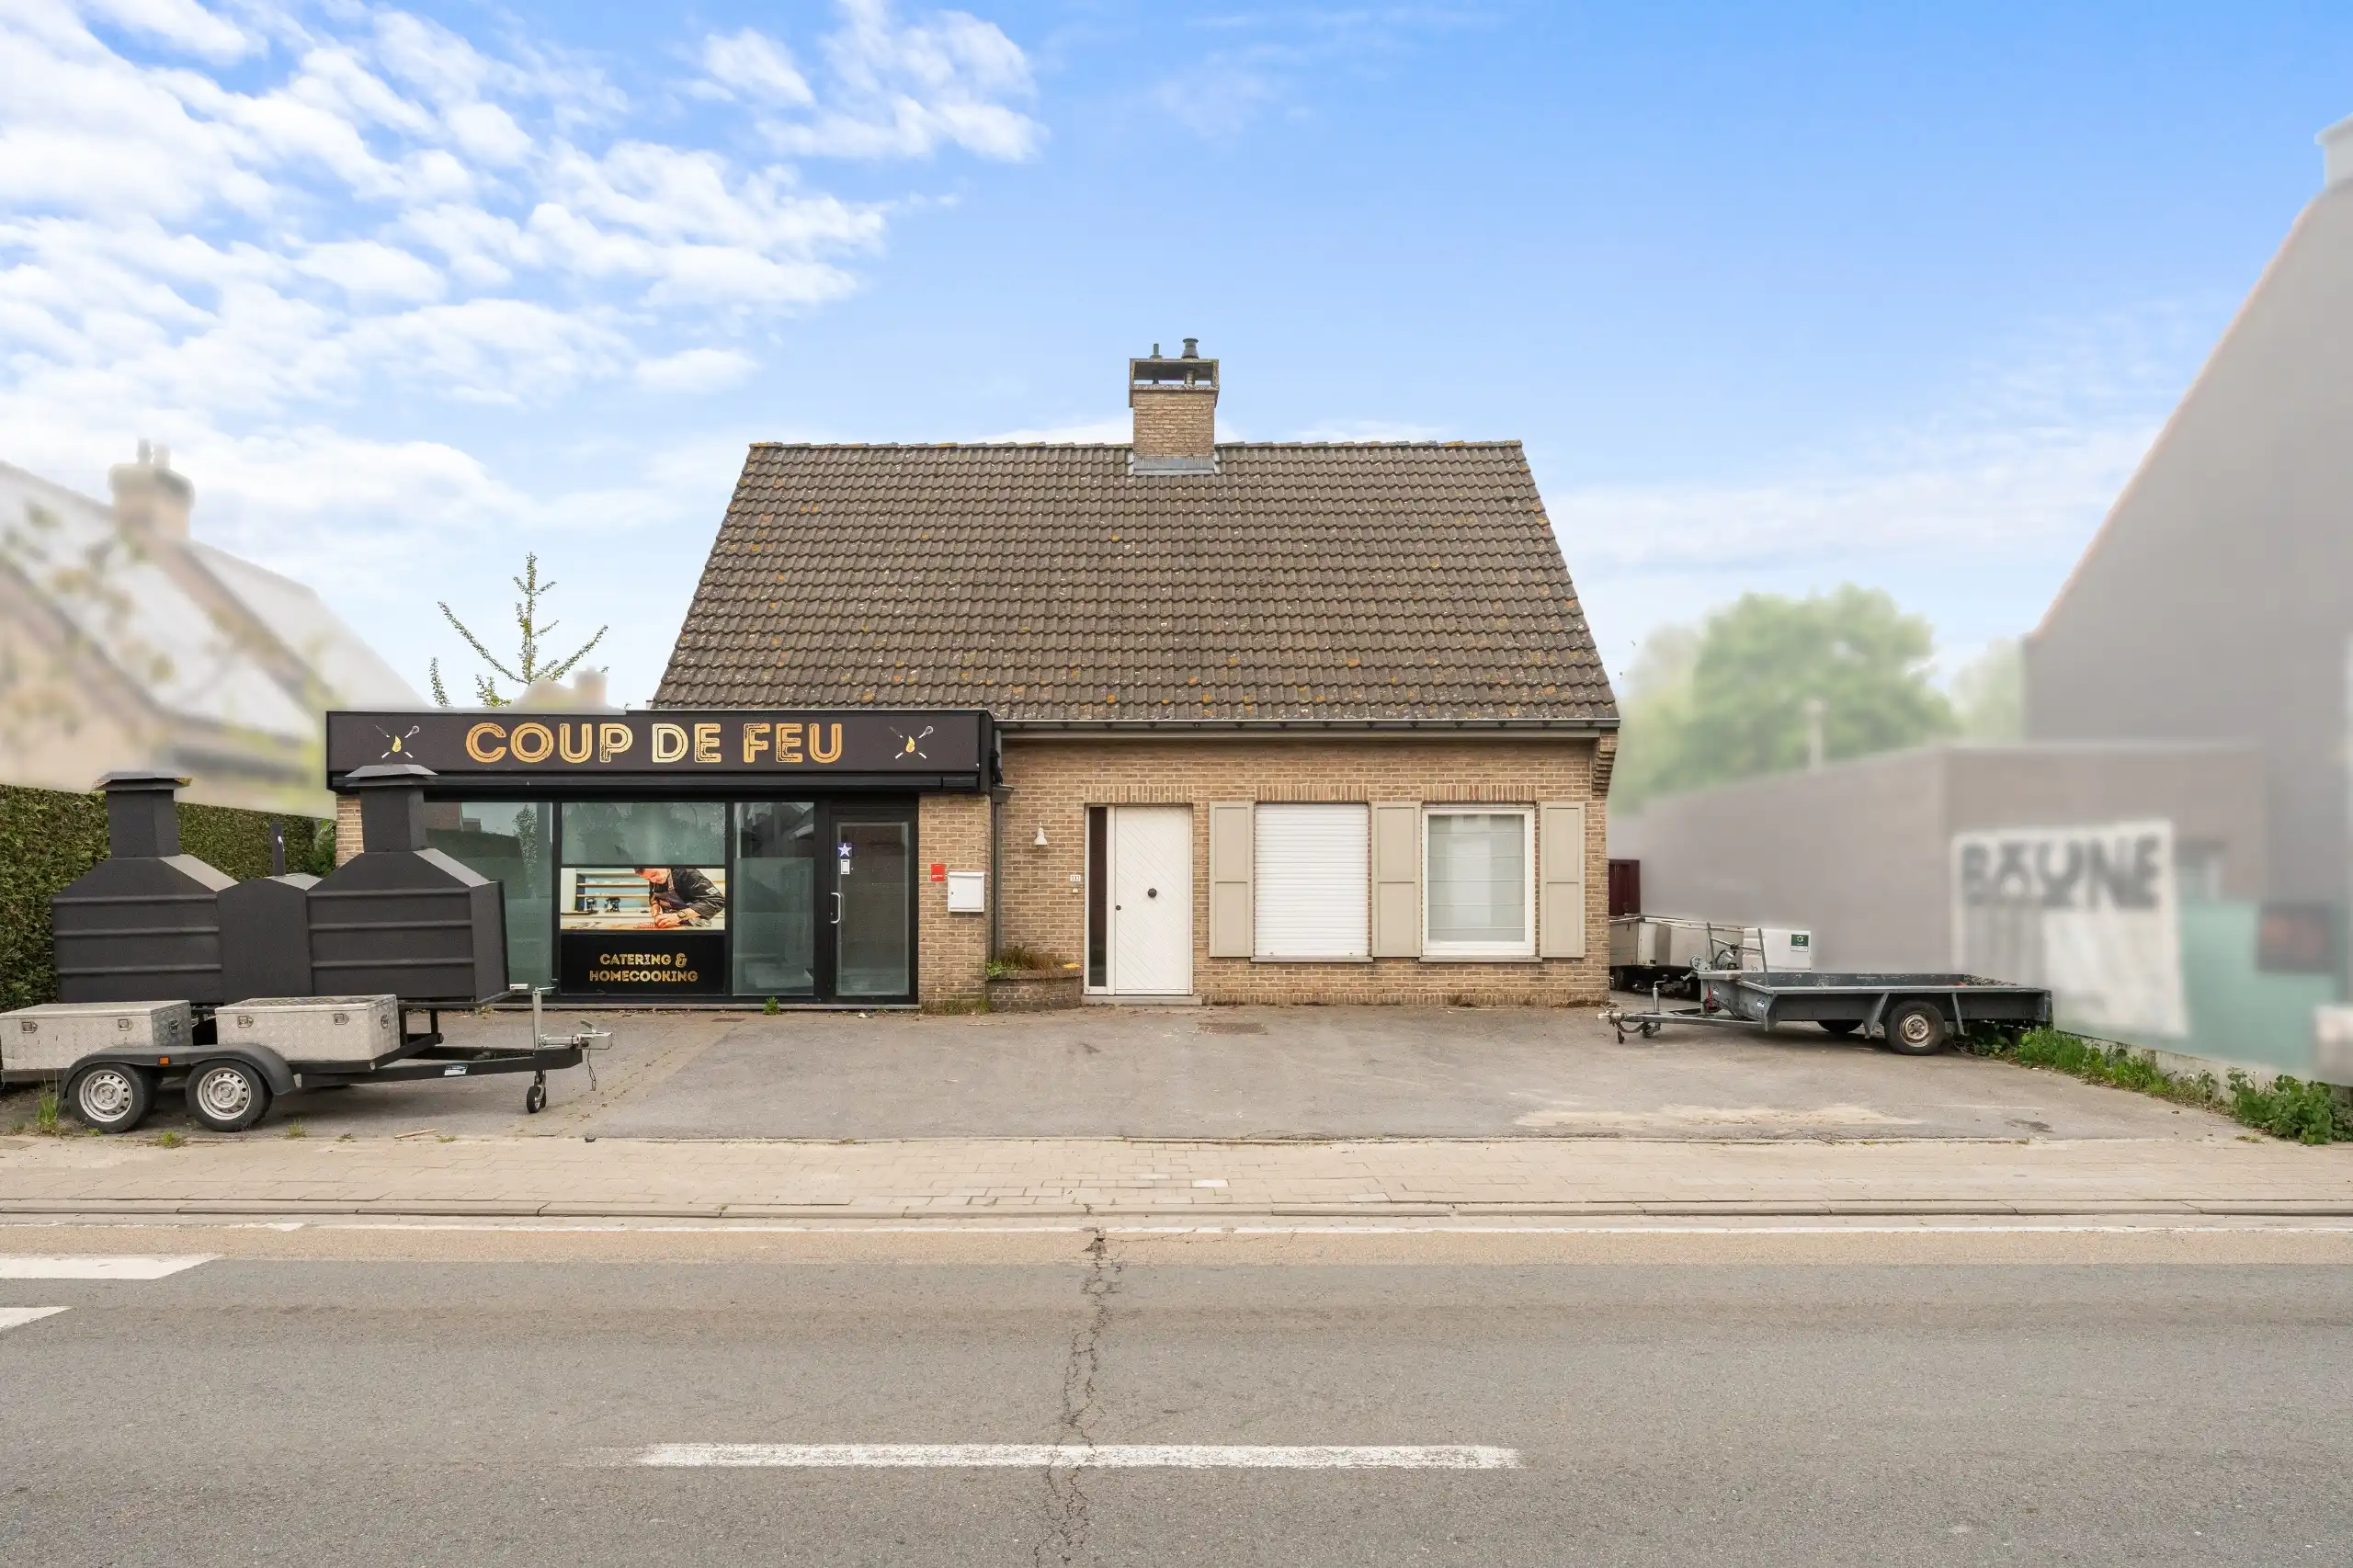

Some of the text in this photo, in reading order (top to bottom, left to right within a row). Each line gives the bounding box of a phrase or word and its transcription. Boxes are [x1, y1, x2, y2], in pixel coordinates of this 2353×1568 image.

[465, 722, 843, 763] COUP DE FEU
[599, 952, 688, 968] CATERING &
[589, 971, 699, 982] HOMECOOKING
